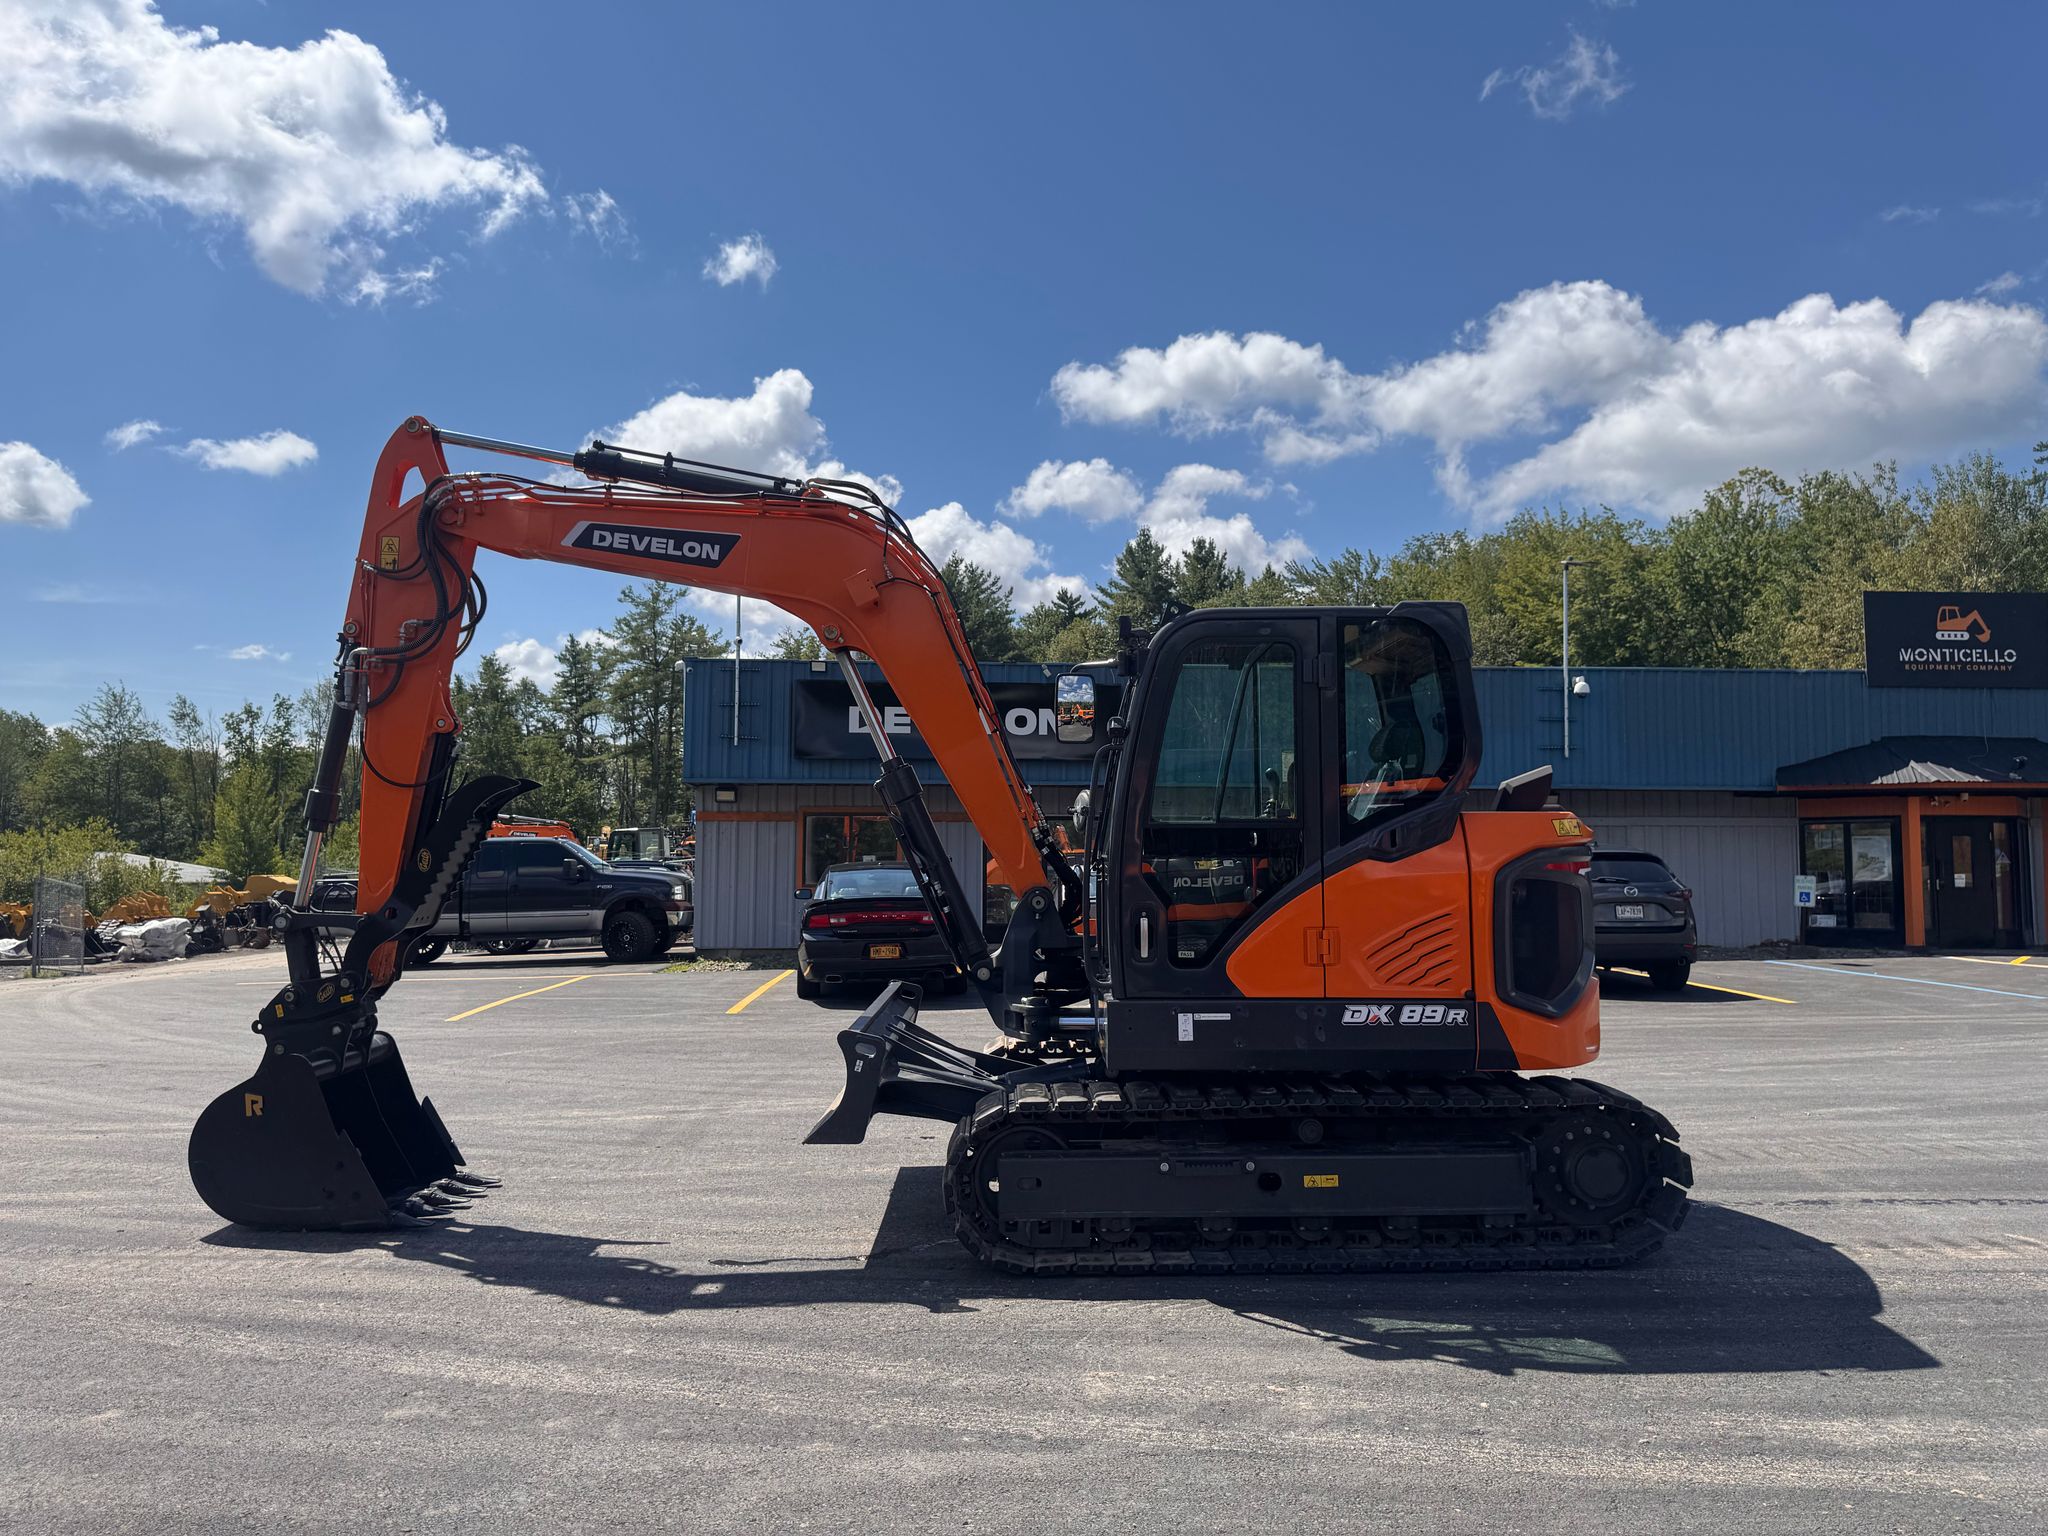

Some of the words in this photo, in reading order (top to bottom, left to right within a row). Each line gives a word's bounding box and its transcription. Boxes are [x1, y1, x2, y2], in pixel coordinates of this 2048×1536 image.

[592, 530, 720, 561] DEVELON
[1899, 648, 2017, 663] MONTICELLO
[1905, 663, 1962, 671] EQUIPMENT
[1966, 664, 2013, 672] COMPANY
[1341, 1005, 1394, 1026] DX
[1399, 1005, 1468, 1026] 89R
